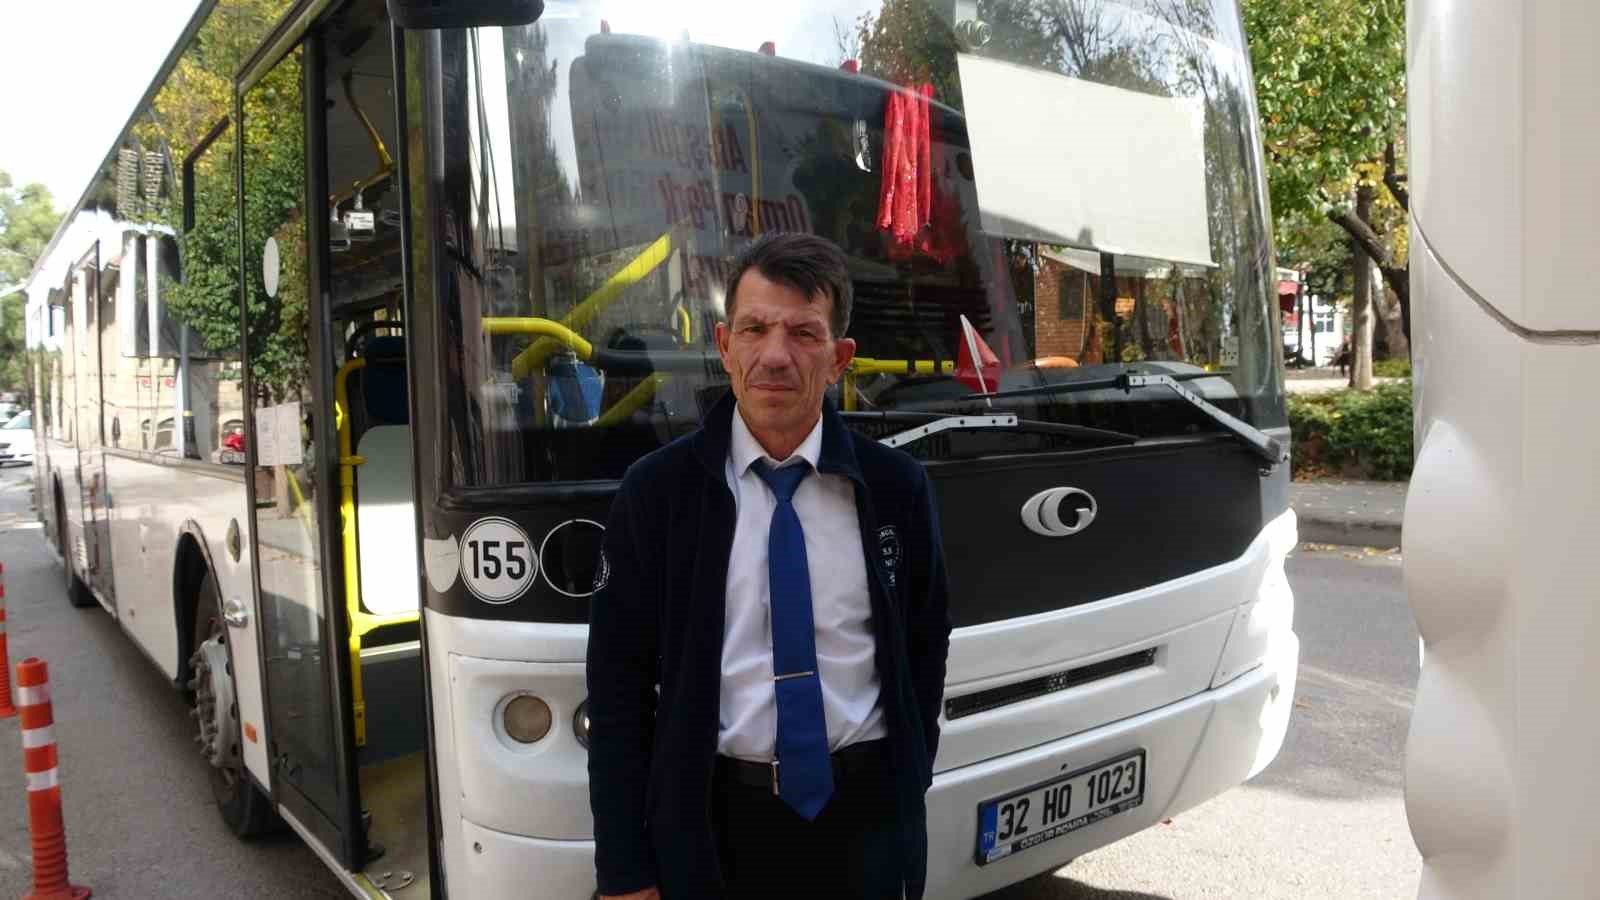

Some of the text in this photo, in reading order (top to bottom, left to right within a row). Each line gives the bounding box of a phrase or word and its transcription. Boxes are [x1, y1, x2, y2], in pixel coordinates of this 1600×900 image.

[468, 540, 526, 580] 155
[998, 798, 1030, 840] 32
[1042, 784, 1072, 825] HO
[1087, 761, 1137, 808] 1023
